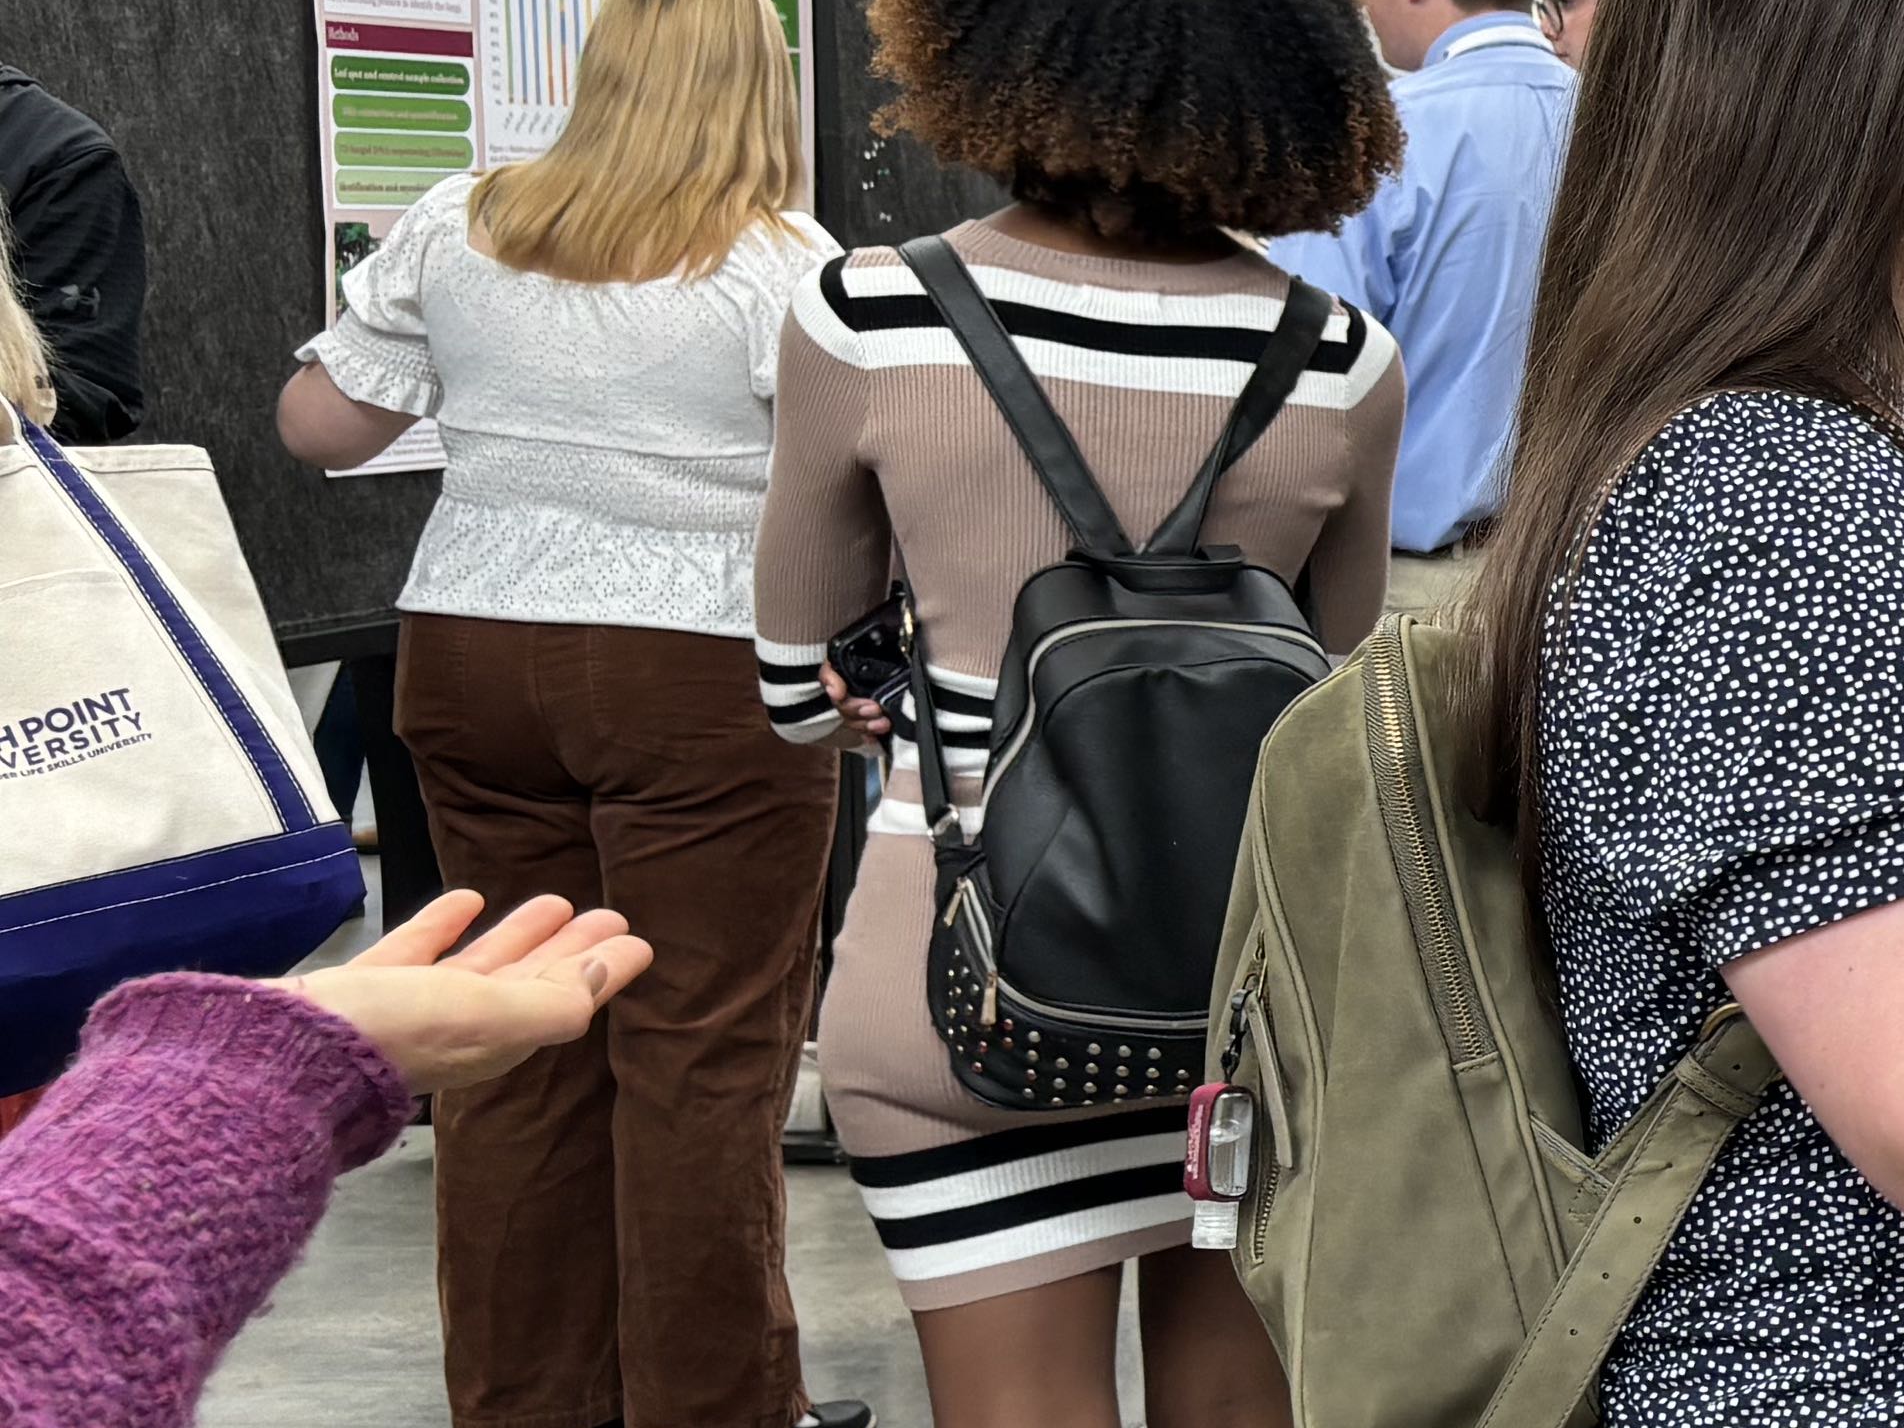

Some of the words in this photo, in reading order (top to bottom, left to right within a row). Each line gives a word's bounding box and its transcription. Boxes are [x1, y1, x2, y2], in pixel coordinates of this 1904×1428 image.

[19, 688, 131, 743] POINT
[47, 754, 86, 772] SKILLS
[87, 733, 152, 759] UNIVERSITY
